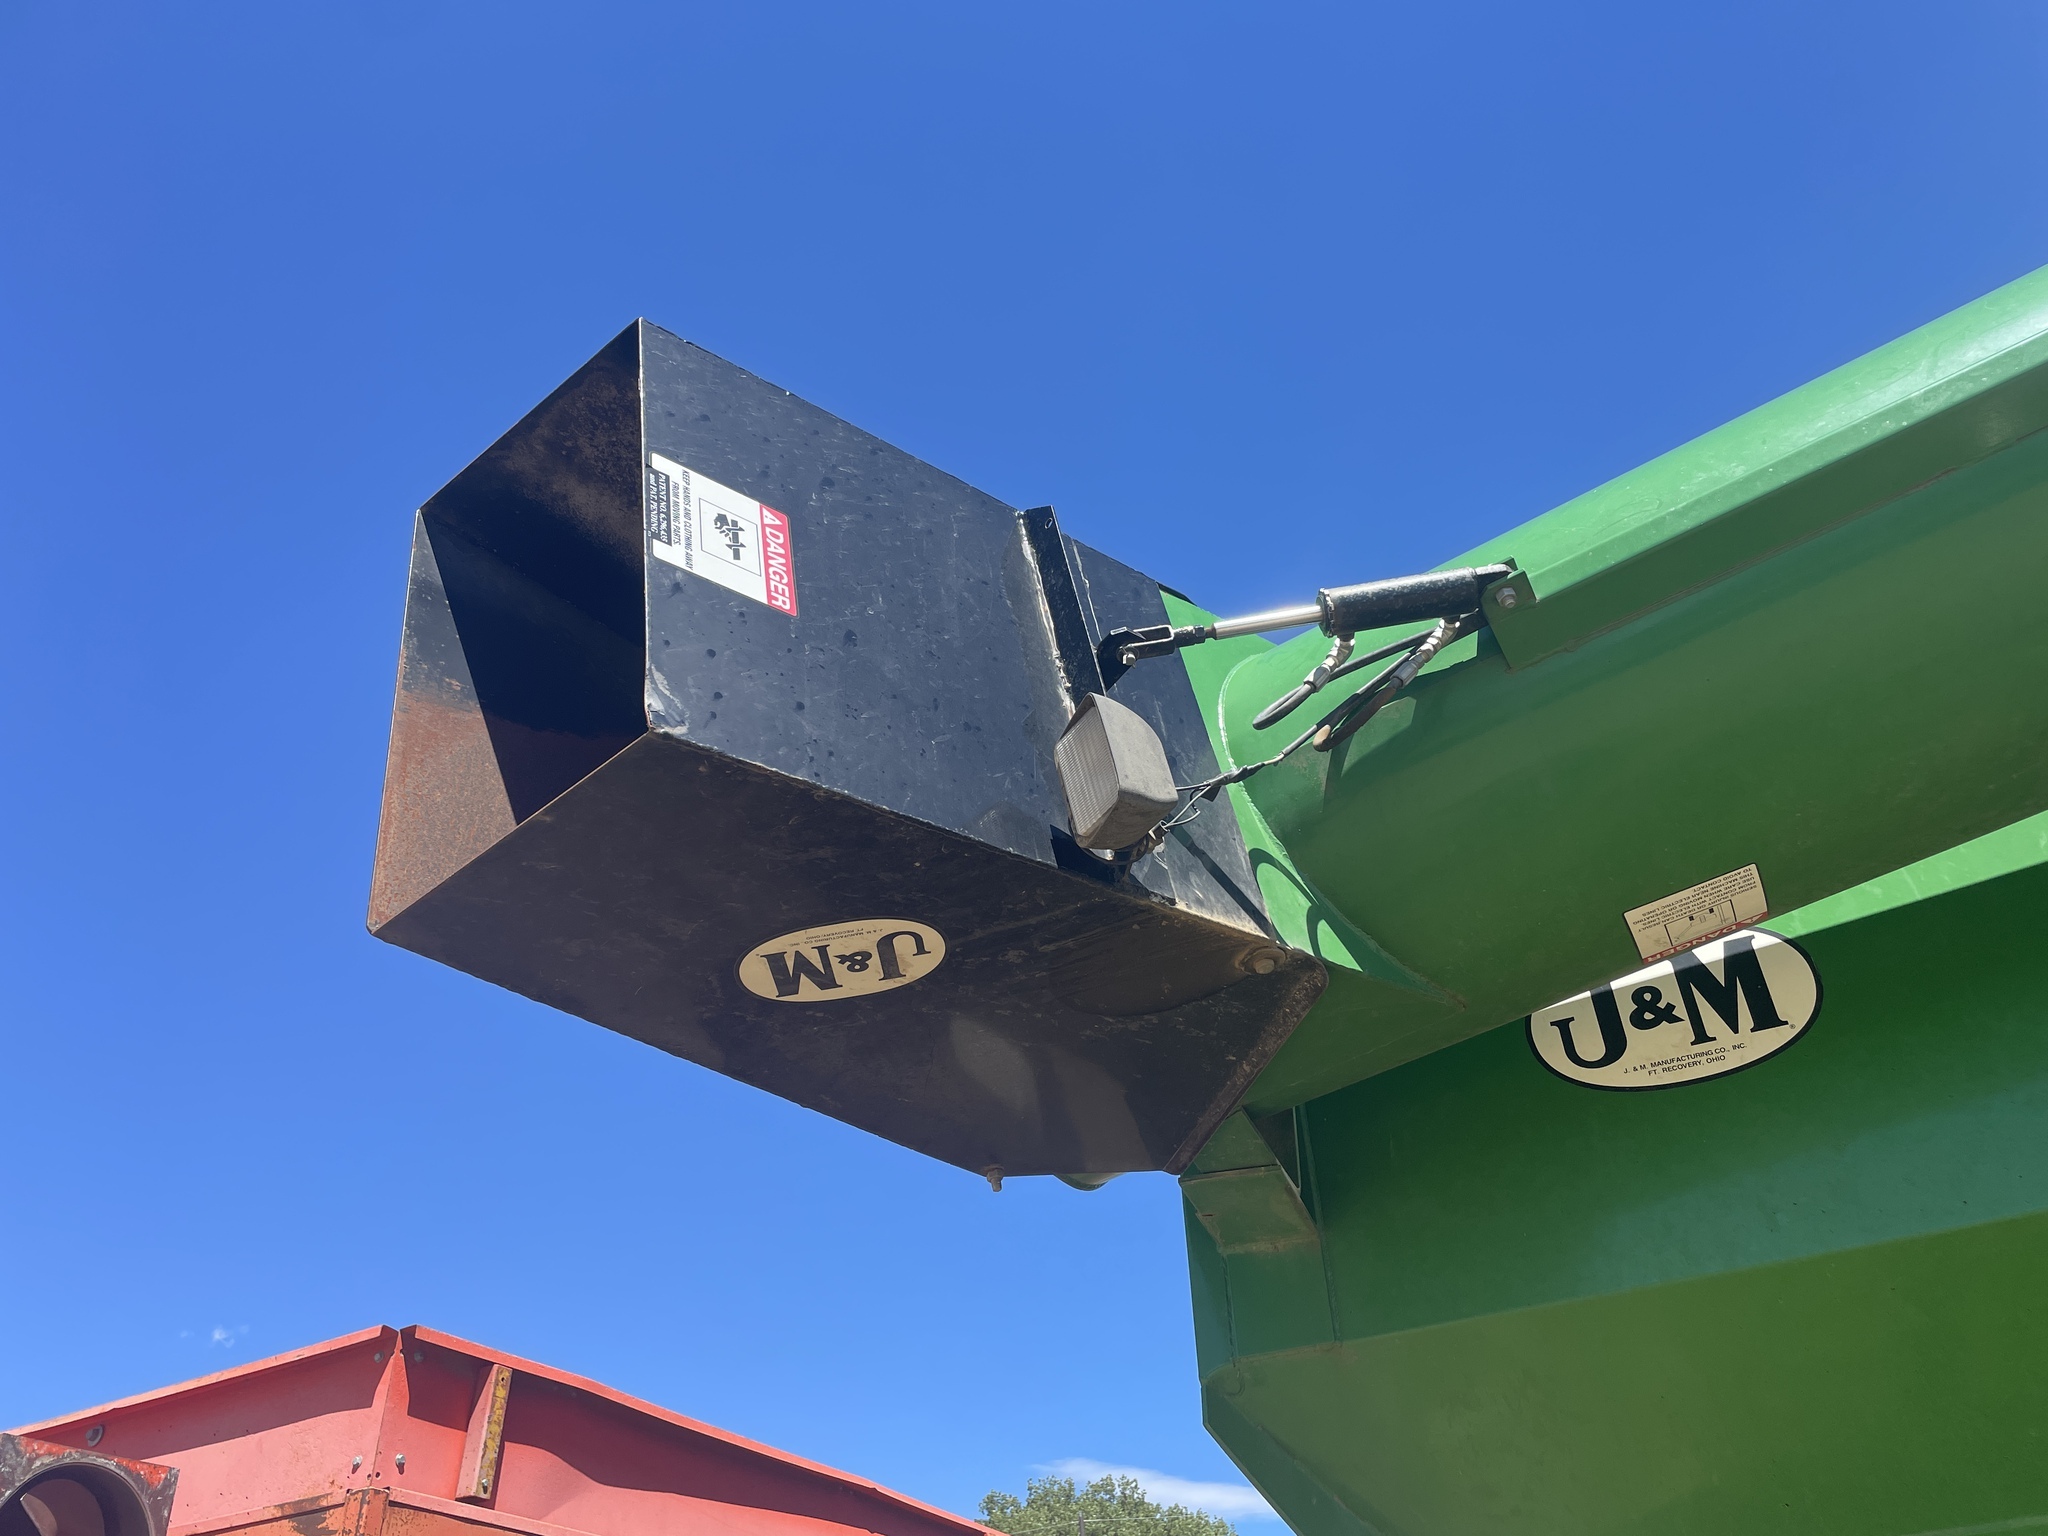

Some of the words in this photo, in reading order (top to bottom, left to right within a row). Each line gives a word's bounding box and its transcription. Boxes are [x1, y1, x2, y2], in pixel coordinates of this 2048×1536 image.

[684, 521, 692, 551] CLOTHING
[765, 527, 790, 609] DANGER
[1722, 870, 1741, 880] AVOID
[1710, 877, 1738, 890] MACHINE
[1723, 881, 1741, 891] CARE
[1738, 881, 1756, 889] FROM
[1691, 888, 1710, 898] NEAR
[1704, 887, 1722, 898] WHEN
[1708, 888, 1737, 901] CONTACT
[1730, 885, 1757, 897] SERIOUS
[1661, 896, 1690, 910] ELECTRIC
[1682, 895, 1703, 908] MOVING
[1691, 899, 1707, 908] WITH
[1632, 909, 1670, 924] OPERATING
[1642, 908, 1659, 916] LINES
[1661, 904, 1692, 920] ELECTRIC
[1676, 908, 1696, 917] DEATH
[1638, 921, 1660, 932] RESULT
[814, 932, 863, 942] MANUFACTURING
[1647, 925, 1737, 962] DANGER
[760, 931, 931, 998] J&M
[1550, 934, 1789, 1069] J&M
[1650, 1049, 1713, 1069] MANUFACTURING
[1732, 1042, 1747, 1050] INC.
[1662, 1060, 1705, 1074] RECOVERY,
[1706, 1054, 1726, 1064] OHIO
